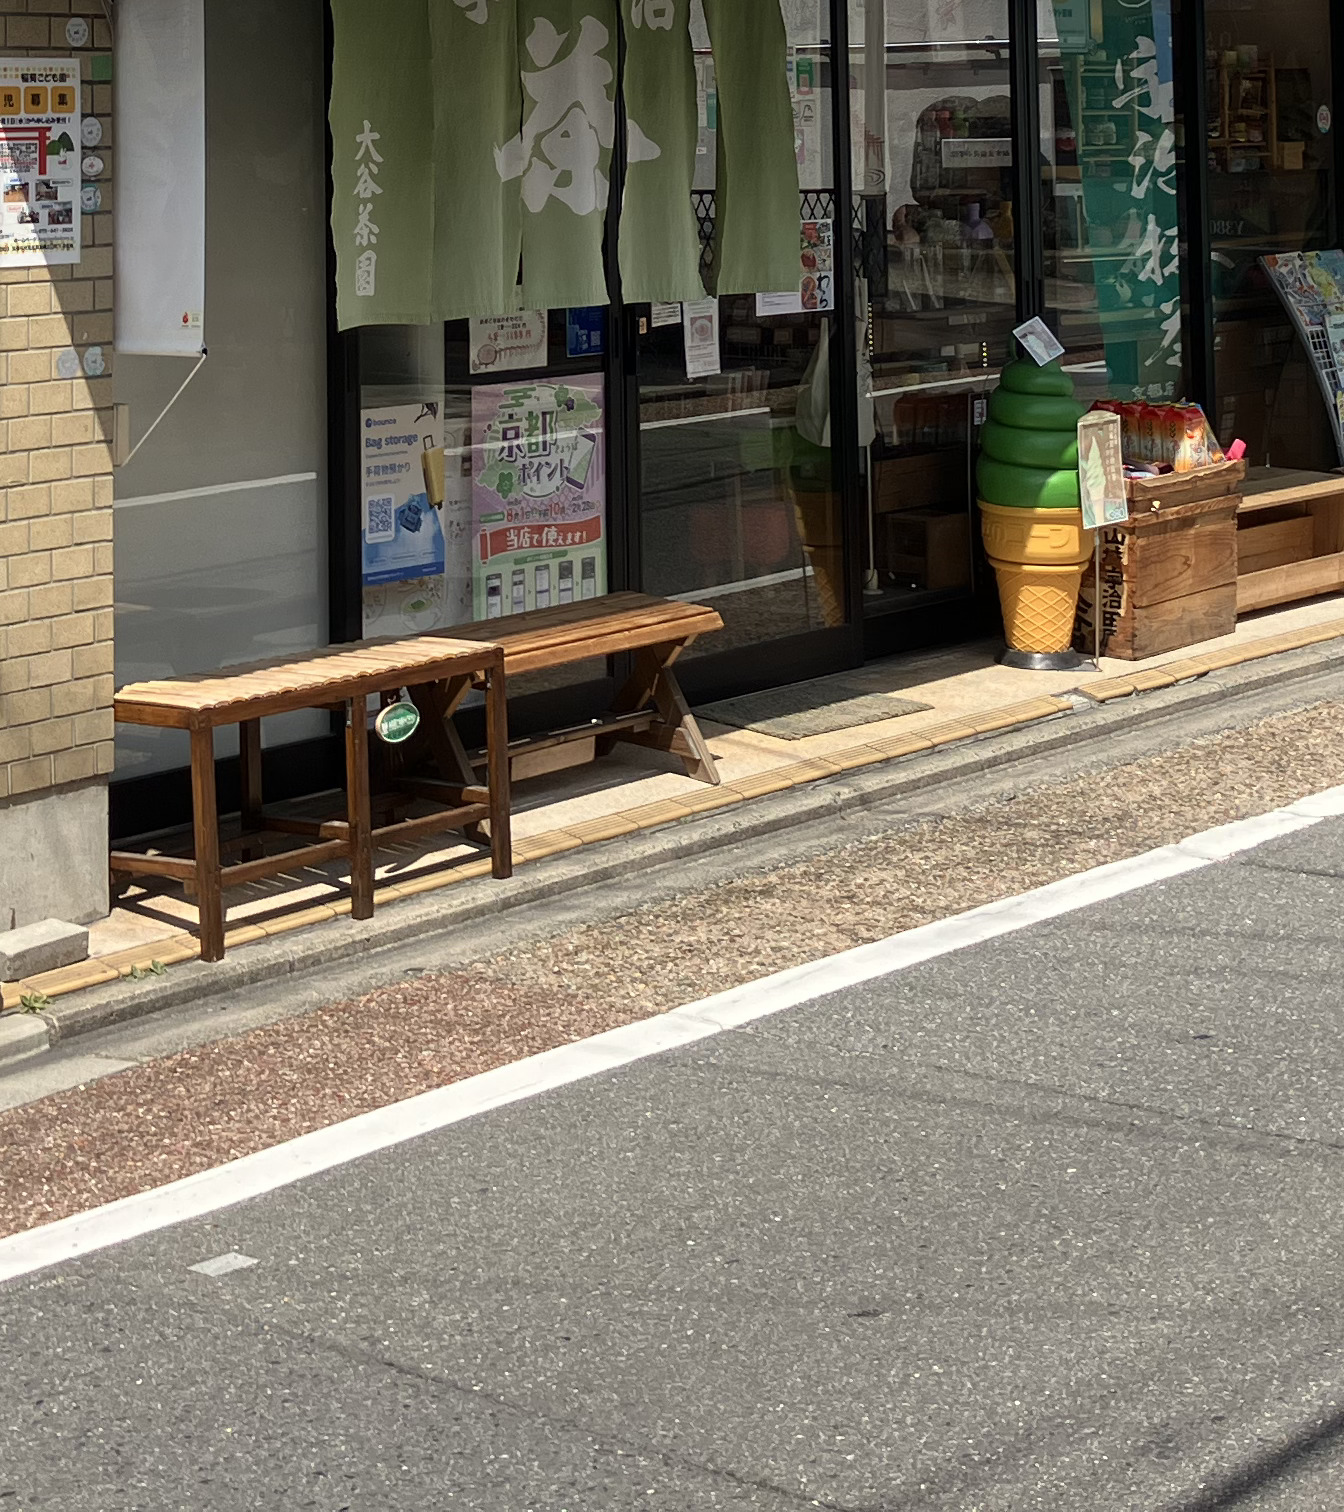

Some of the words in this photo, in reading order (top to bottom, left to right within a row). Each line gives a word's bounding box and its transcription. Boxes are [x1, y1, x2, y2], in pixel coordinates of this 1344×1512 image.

[493, 15, 662, 216] 茶
[351, 119, 384, 297] 大谷茶園
[365, 437, 383, 450] Bag
[384, 432, 419, 448] storage
[497, 410, 557, 462] 京都
[518, 458, 569, 486] ポイント
